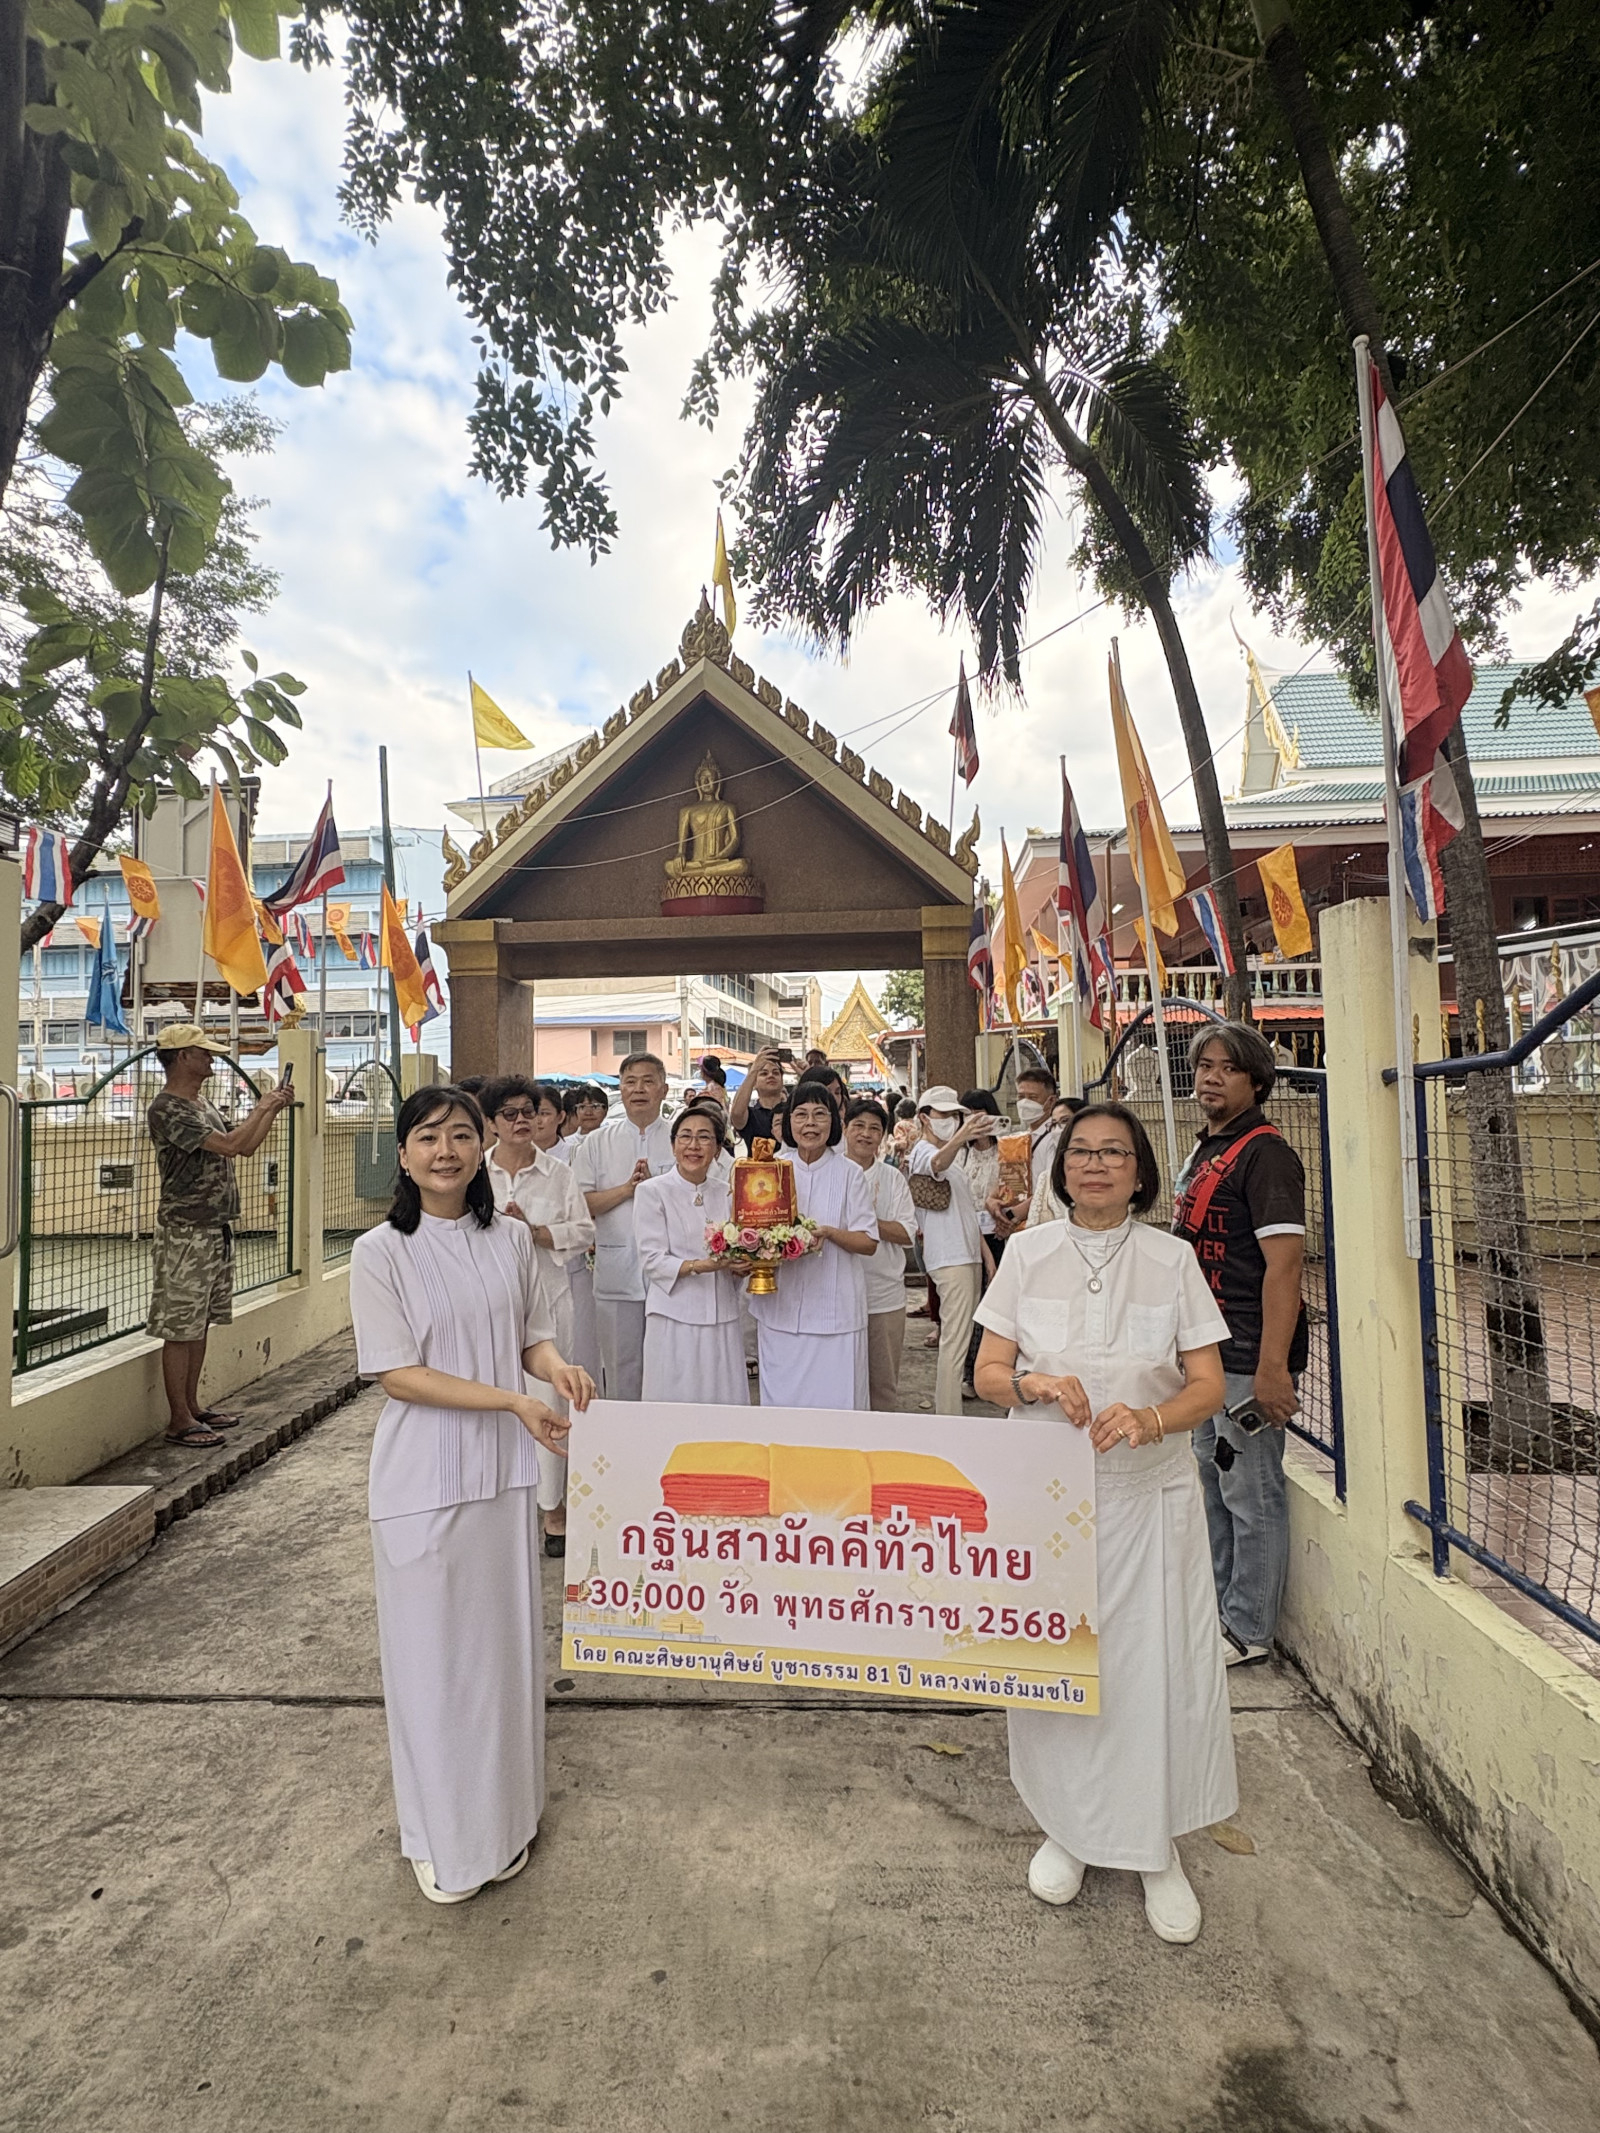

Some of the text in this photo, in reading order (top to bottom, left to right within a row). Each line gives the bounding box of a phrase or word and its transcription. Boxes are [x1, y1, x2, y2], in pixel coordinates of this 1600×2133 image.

[622, 1511, 1031, 1580] กฐินสามัคคีทั่วไทย
[591, 1579, 1067, 1640] 30,000 วัด พุทธศักราช 2568
[573, 1640, 1084, 1703] โดย คณะศิษยานุศิษย์ บูชาธรรม 81 ปี หลวงพ่อธัมมชโย
